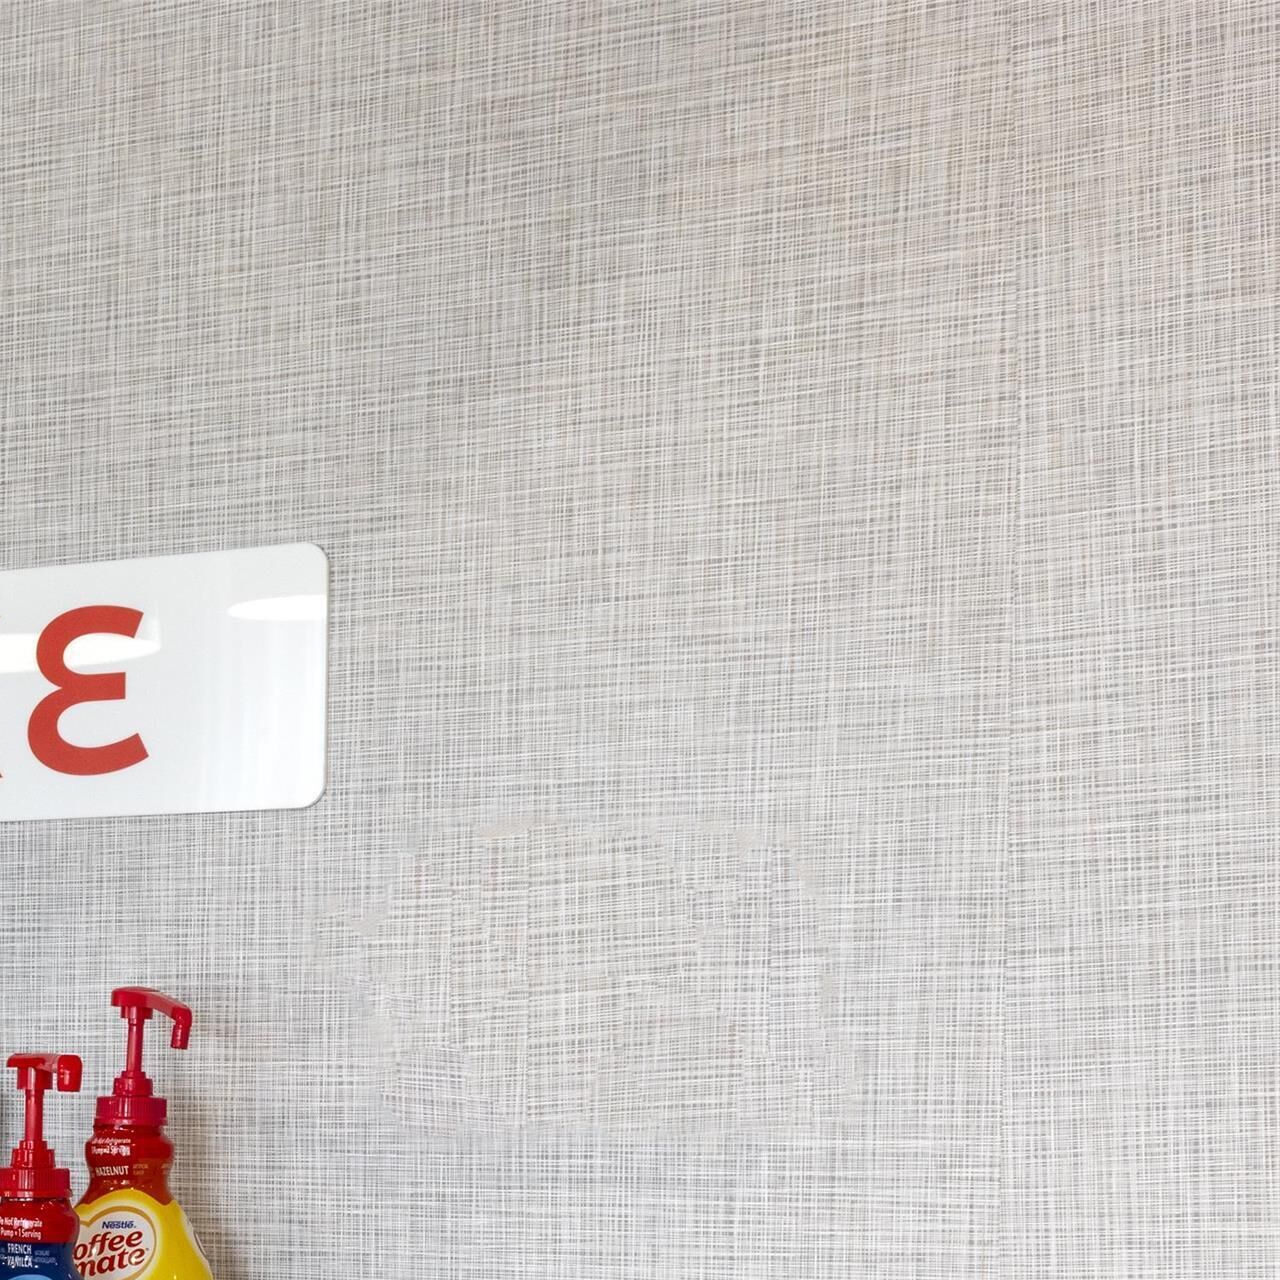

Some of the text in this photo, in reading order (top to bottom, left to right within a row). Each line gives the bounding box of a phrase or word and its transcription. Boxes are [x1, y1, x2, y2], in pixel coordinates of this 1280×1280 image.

[95, 1165, 129, 1176] HAZELNUT
[22, 1228, 41, 1240] Serving
[8, 1243, 32, 1254] FRENCH
[73, 1231, 143, 1260] offee
[7, 1255, 33, 1268] VANILLA
